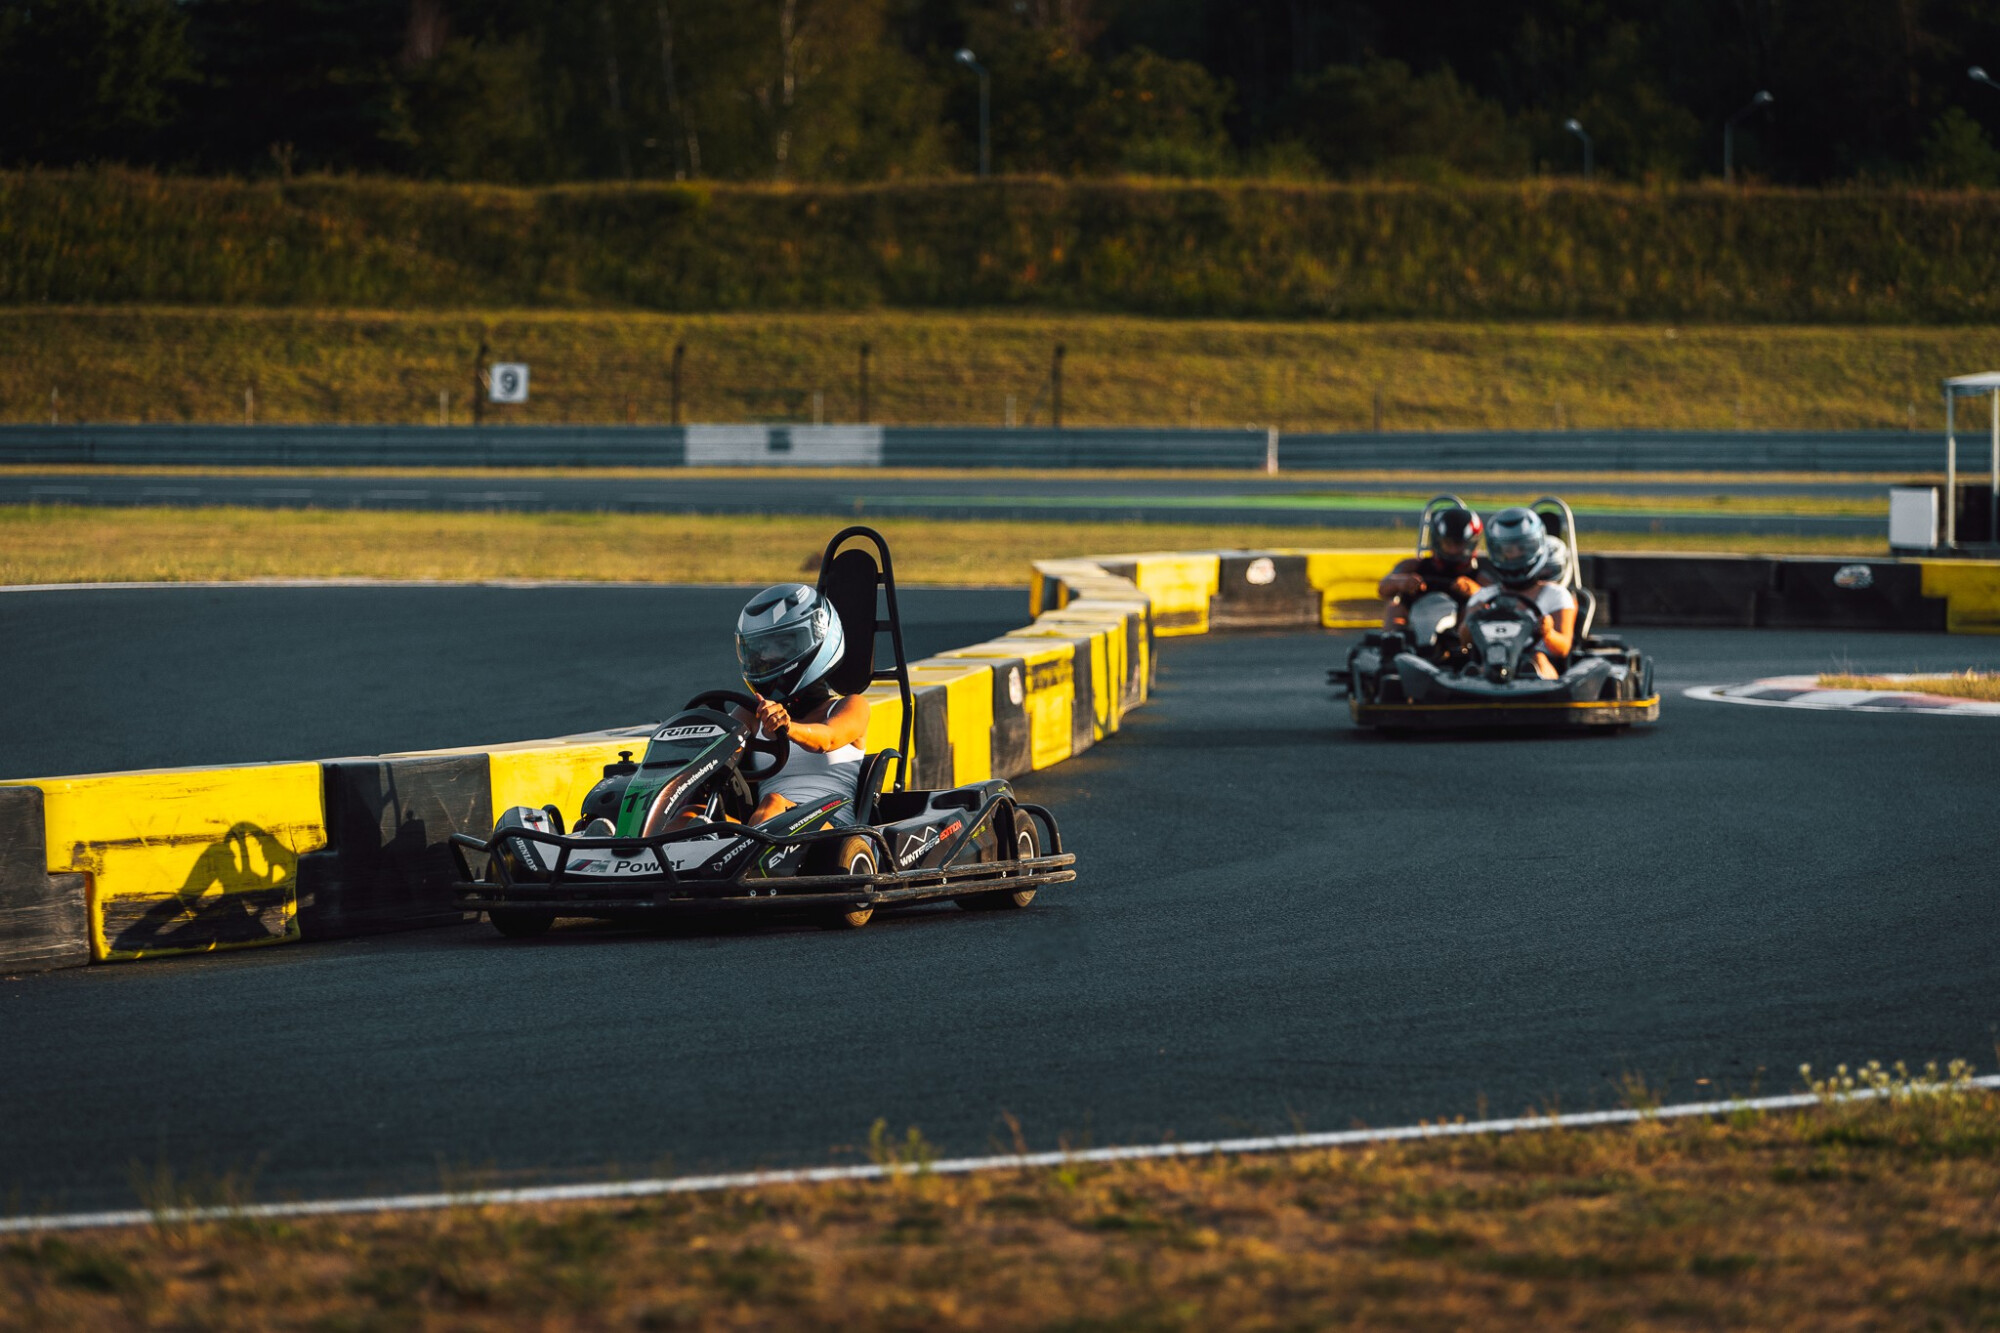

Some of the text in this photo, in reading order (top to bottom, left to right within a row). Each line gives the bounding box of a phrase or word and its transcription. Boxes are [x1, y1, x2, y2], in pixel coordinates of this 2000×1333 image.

[624, 789, 655, 813] 11
[515, 839, 539, 872] DUNLOP
[722, 838, 755, 865] DUNL
